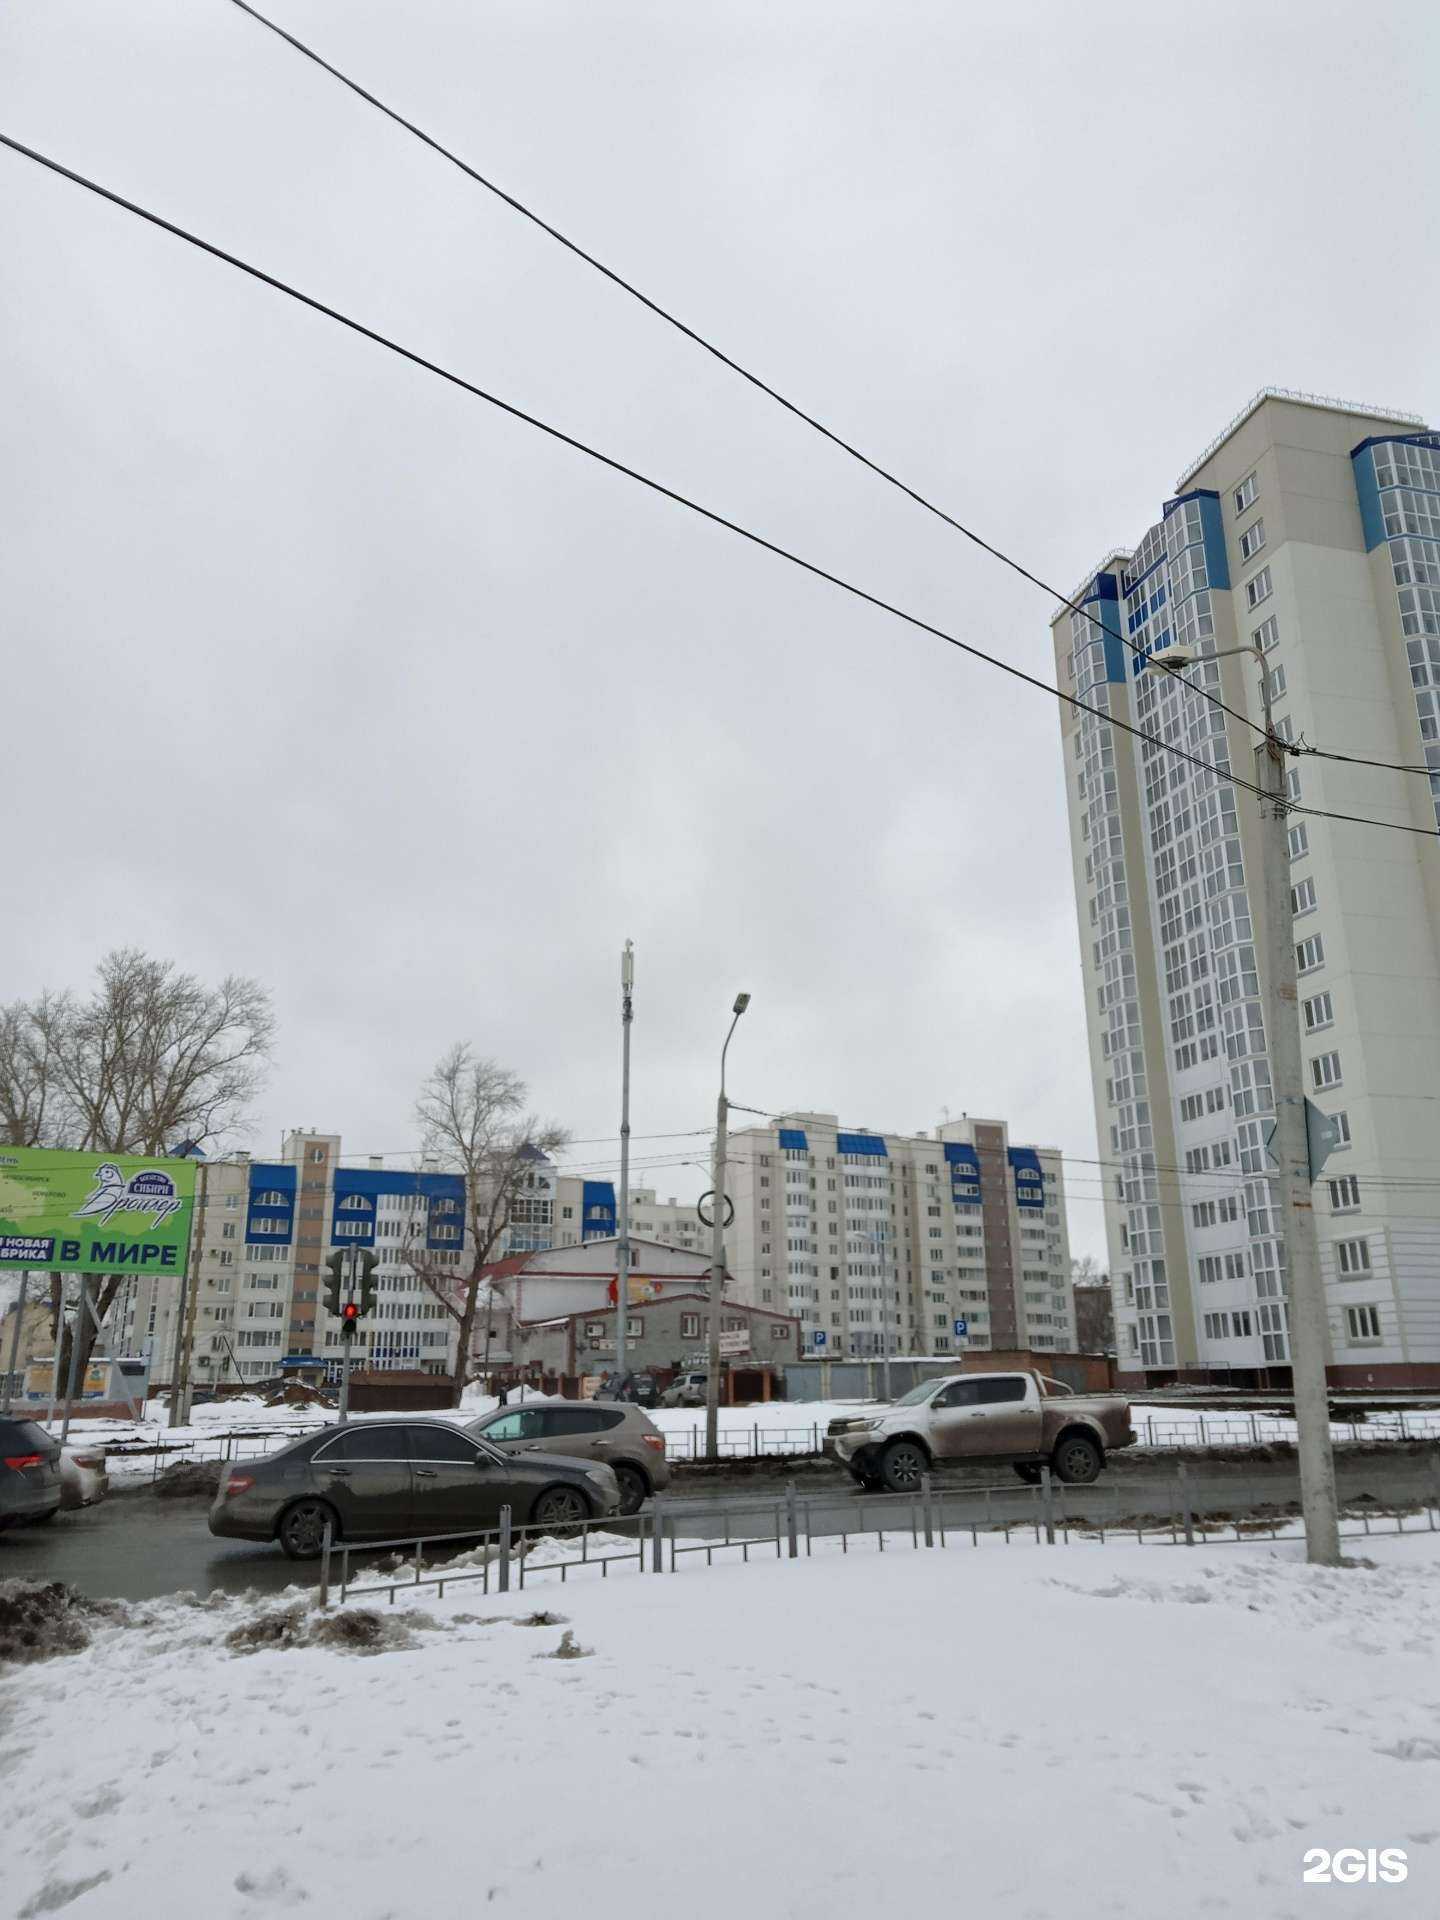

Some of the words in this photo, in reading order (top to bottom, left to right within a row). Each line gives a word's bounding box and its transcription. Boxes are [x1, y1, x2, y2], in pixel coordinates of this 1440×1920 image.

[6, 1238, 49, 1249] НОВАЯ
[61, 1240, 81, 1261] В
[90, 1241, 178, 1266] МИРЕ
